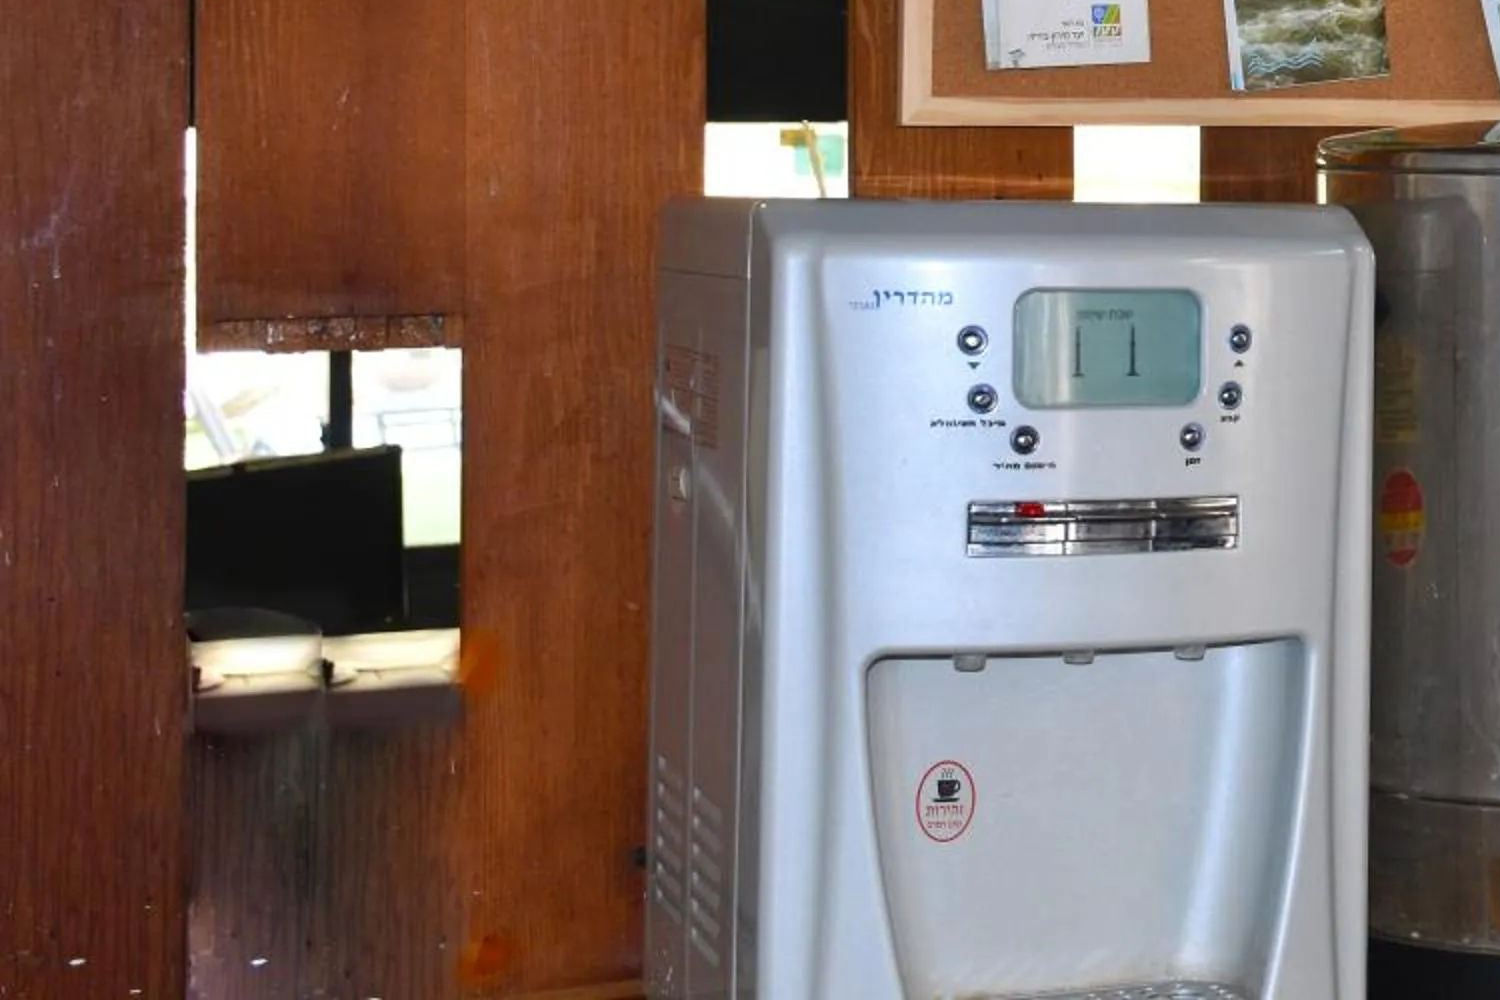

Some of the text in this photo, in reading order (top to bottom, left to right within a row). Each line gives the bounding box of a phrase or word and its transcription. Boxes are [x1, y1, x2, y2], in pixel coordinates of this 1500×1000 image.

[873, 289, 953, 308] מהדרין
[1185, 457, 1201, 467] זמן
[926, 804, 964, 817] זהירות
